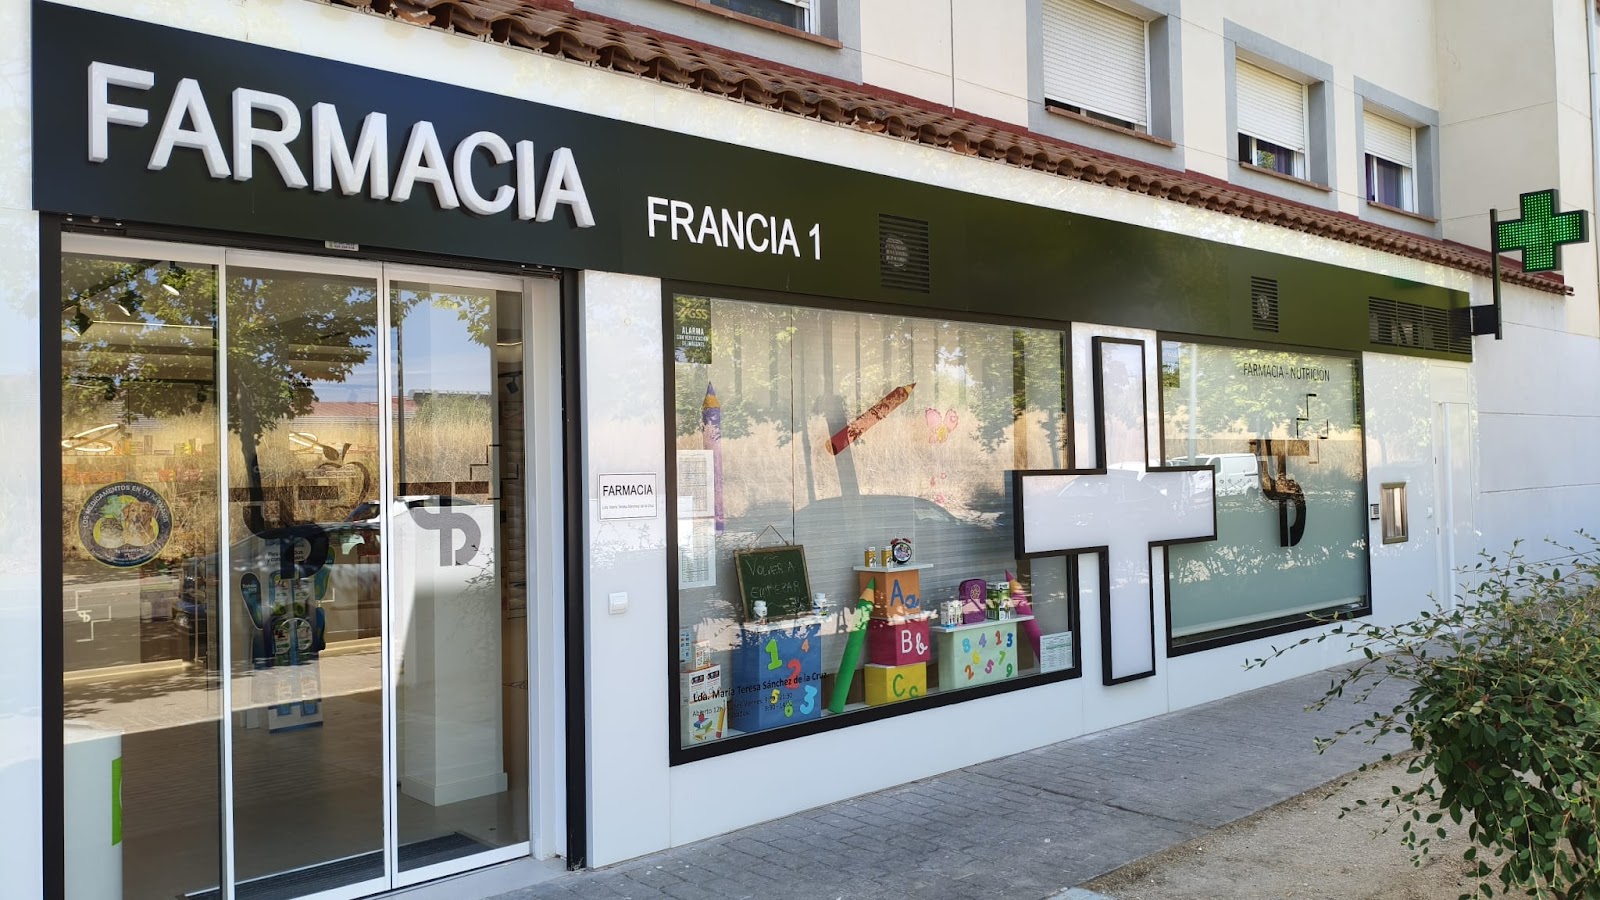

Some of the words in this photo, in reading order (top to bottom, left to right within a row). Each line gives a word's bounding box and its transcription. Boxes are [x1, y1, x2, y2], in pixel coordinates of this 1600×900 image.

[87, 60, 596, 228] FARMACIA
[647, 195, 801, 258] FRANCIA
[809, 223, 821, 261] 1
[688, 308, 708, 320] GSS
[682, 327, 705, 336] ALARMA
[1243, 362, 1285, 379] FARMACIA
[602, 484, 654, 497] FARMACIA
[87, 485, 131, 515] MEDICAMENTOS
[142, 488, 151, 497] TU
[801, 638, 810, 653] 4
[962, 638, 971, 653] 8
[978, 632, 987, 648] 4
[1006, 632, 1013, 648] 3
[765, 638, 783, 671] 1
[998, 651, 1006, 665] 7
[964, 664, 974, 680] 2
[985, 659, 995, 674] 5
[1006, 663, 1013, 678] 9
[737, 684, 761, 695] Teresa
[762, 677, 791, 690] Sánchez
[794, 675, 802, 684] de
[803, 673, 810, 682] la
[812, 671, 827, 681] Cruz
[785, 660, 802, 690] 2
[769, 688, 781, 704] 5
[800, 684, 818, 715] 3
